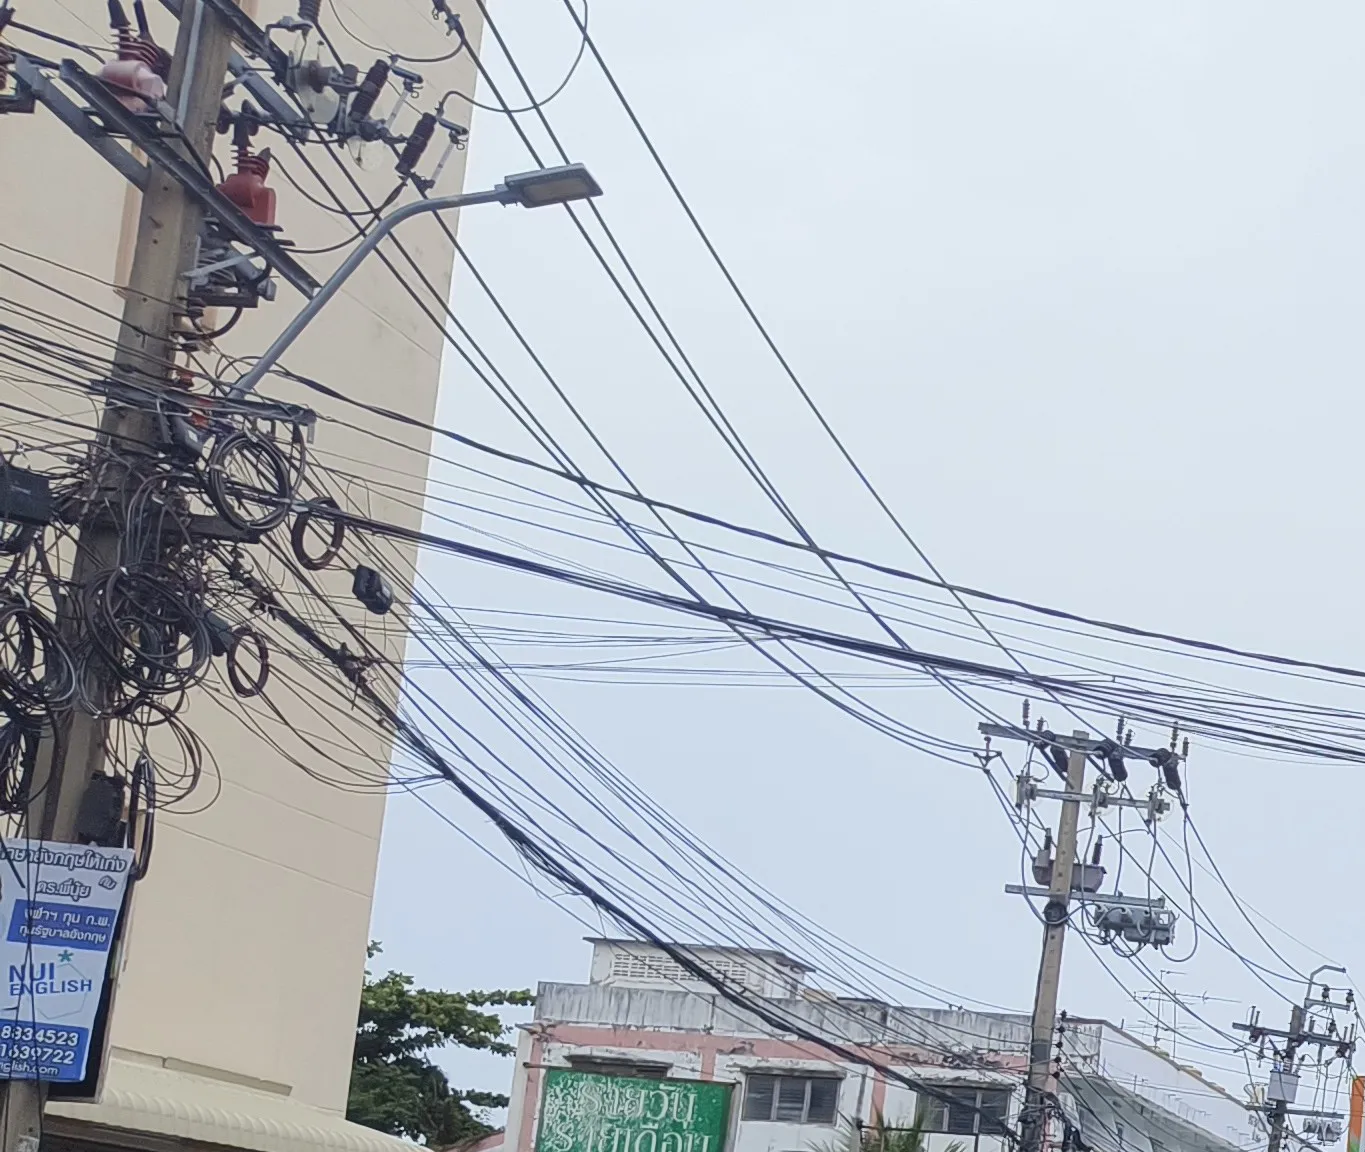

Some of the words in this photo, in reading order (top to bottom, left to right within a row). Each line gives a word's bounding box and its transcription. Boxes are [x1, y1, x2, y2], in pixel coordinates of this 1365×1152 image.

[0, 846, 127, 872] าษาอังกฤษให้เก่ง
[9, 962, 55, 982] NUI
[10, 979, 92, 997] ENGLISH
